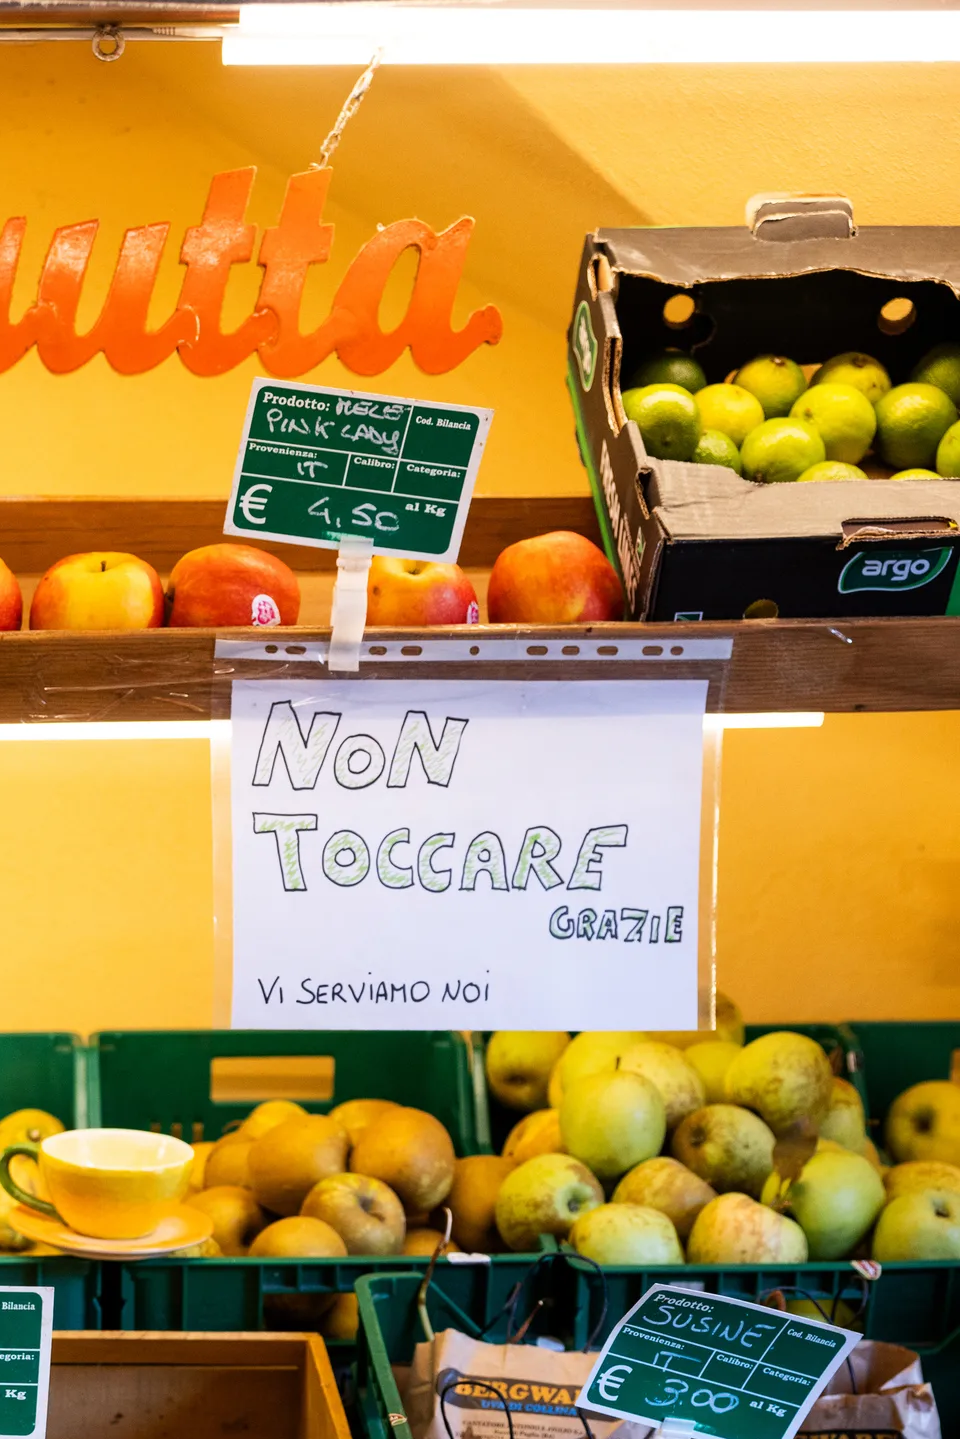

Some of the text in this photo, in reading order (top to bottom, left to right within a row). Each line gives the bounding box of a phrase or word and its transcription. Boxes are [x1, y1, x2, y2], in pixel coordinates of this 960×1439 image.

[263, 392, 408, 420] Prodotto: MELE
[266, 408, 401, 455] PINK LADY
[416, 415, 472, 431] Cod. Bilancia
[248, 443, 318, 459] Provenienza:
[297, 461, 328, 478] IT
[353, 457, 395, 469] Calibro:
[406, 464, 461, 478] Categoria:
[239, 484, 273, 525] €
[405, 501, 446, 517] al Kg
[862, 559, 930, 581] argo
[252, 811, 629, 893] TOCCARE
[549, 905, 684, 945] GRAZIE
[1, 1301, 35, 1311] Bilancia
[653, 1293, 715, 1314] Prodotto:
[642, 1305, 776, 1348] SUSINE
[622, 1326, 685, 1350] Provenienza:
[787, 1328, 837, 1348] Cod. Bilancia
[652, 1351, 701, 1372] IT
[716, 1353, 754, 1370] Calibro:
[597, 1364, 633, 1402] €
[762, 1367, 811, 1386] Categoria:
[5, 1389, 27, 1400] Kg
[525, 1403, 578, 1416] COLLINA
[749, 1399, 788, 1418] al Kg
